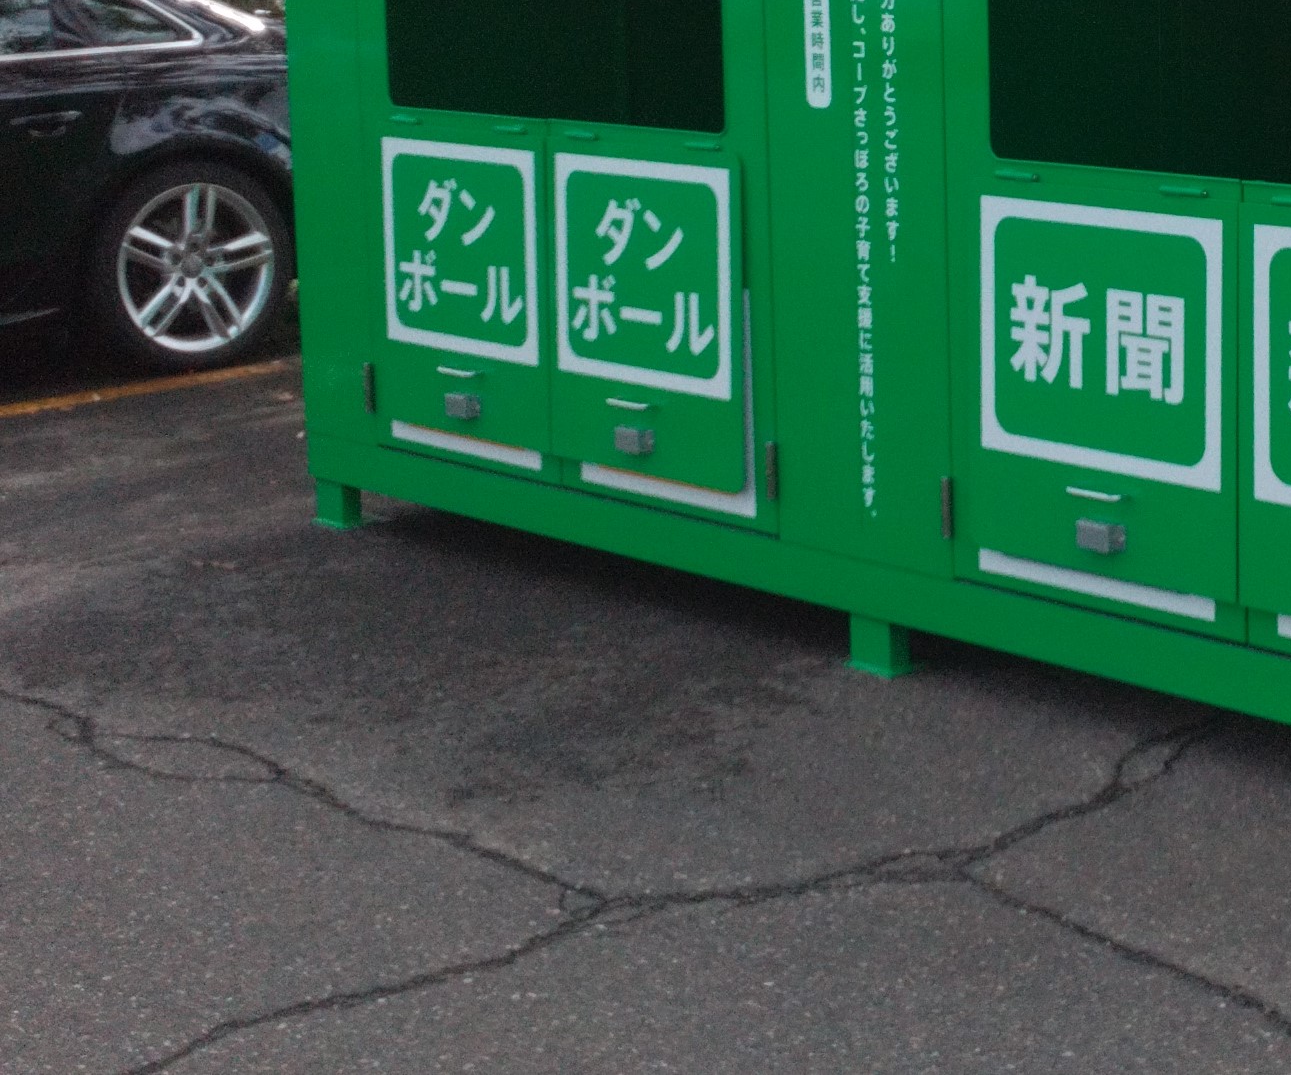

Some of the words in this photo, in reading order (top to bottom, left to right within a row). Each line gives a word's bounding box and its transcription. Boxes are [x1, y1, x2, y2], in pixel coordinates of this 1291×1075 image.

[417, 178, 496, 246] ダン
[595, 197, 684, 270] ダン
[399, 249, 523, 325] ボール
[572, 273, 715, 356] ボール
[1009, 274, 1186, 405] 新聞
